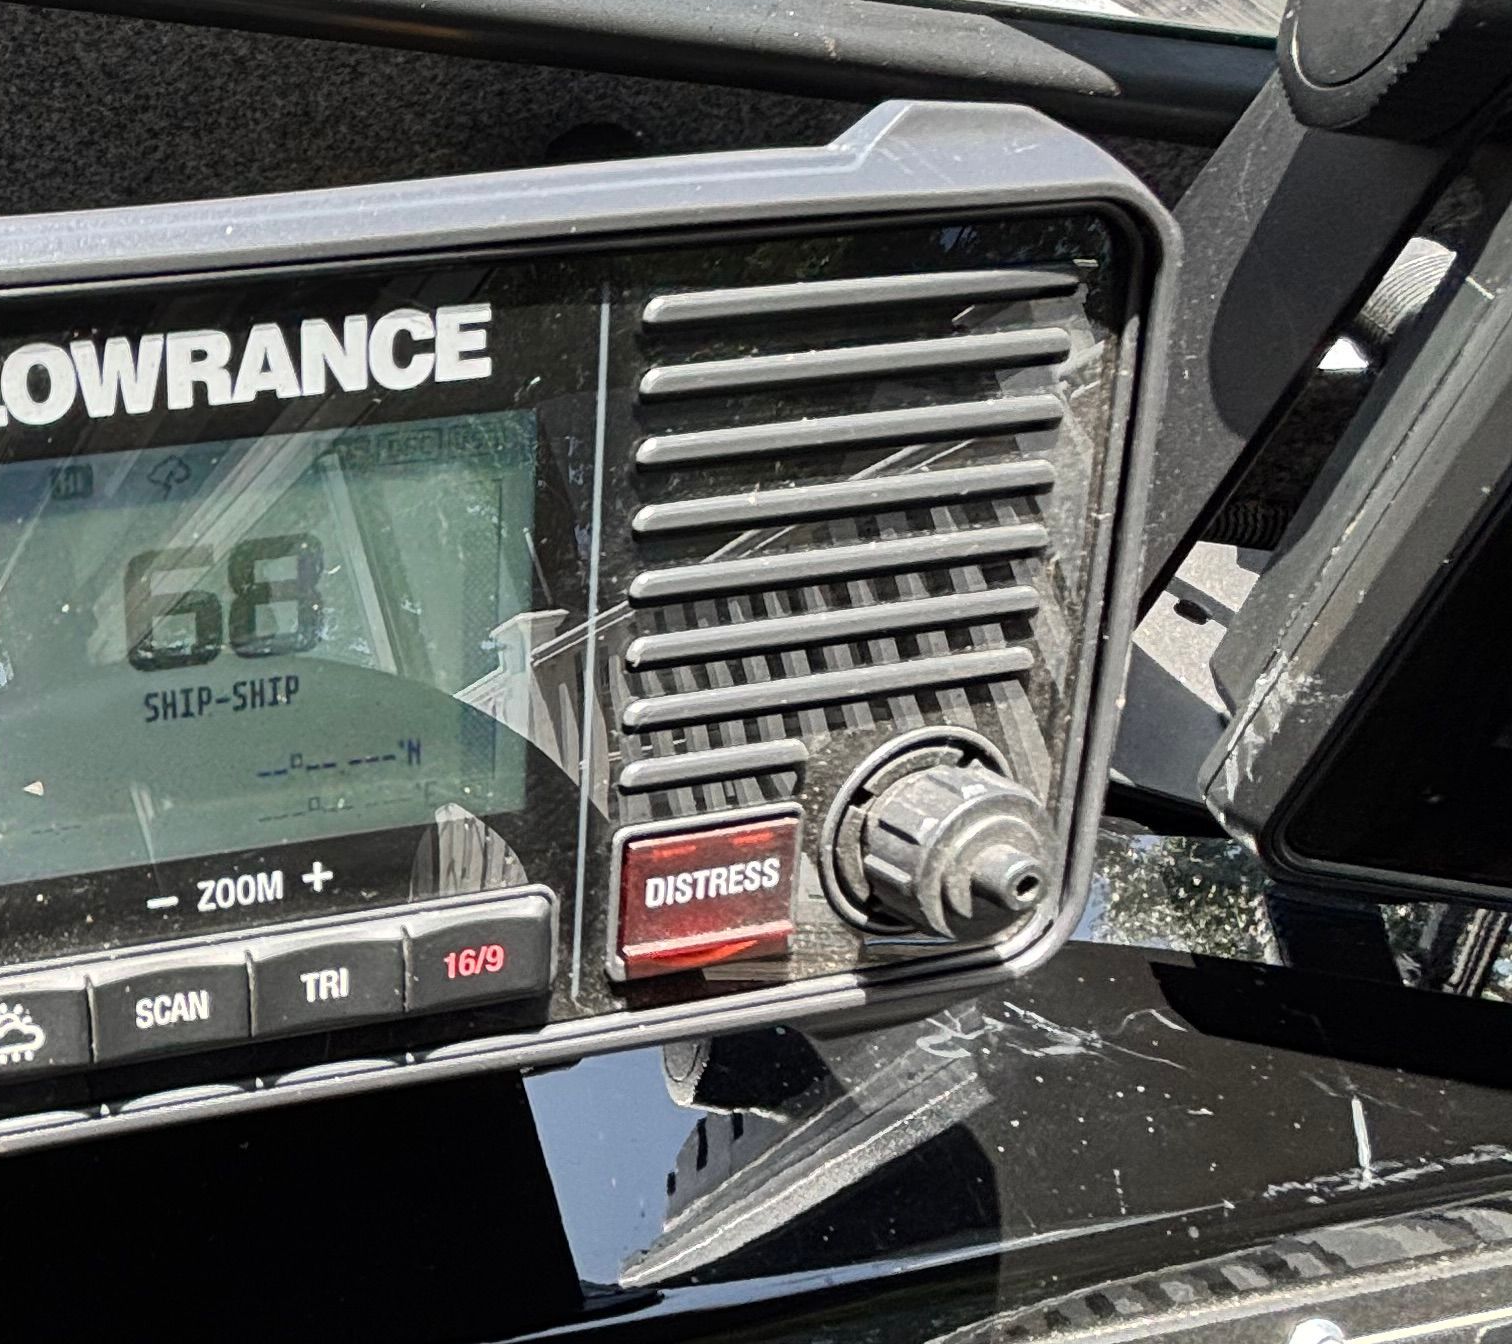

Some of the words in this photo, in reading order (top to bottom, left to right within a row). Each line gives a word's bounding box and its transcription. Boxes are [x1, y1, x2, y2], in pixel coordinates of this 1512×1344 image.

[123, 532, 324, 673] 68
[143, 674, 301, 725] SHIP-SHIP
[196, 869, 284, 913] ZOOM
[644, 856, 781, 910] DISTRESS
[443, 943, 506, 980] 16/9
[299, 966, 350, 1004] TRI
[134, 989, 211, 1030] SCAN
